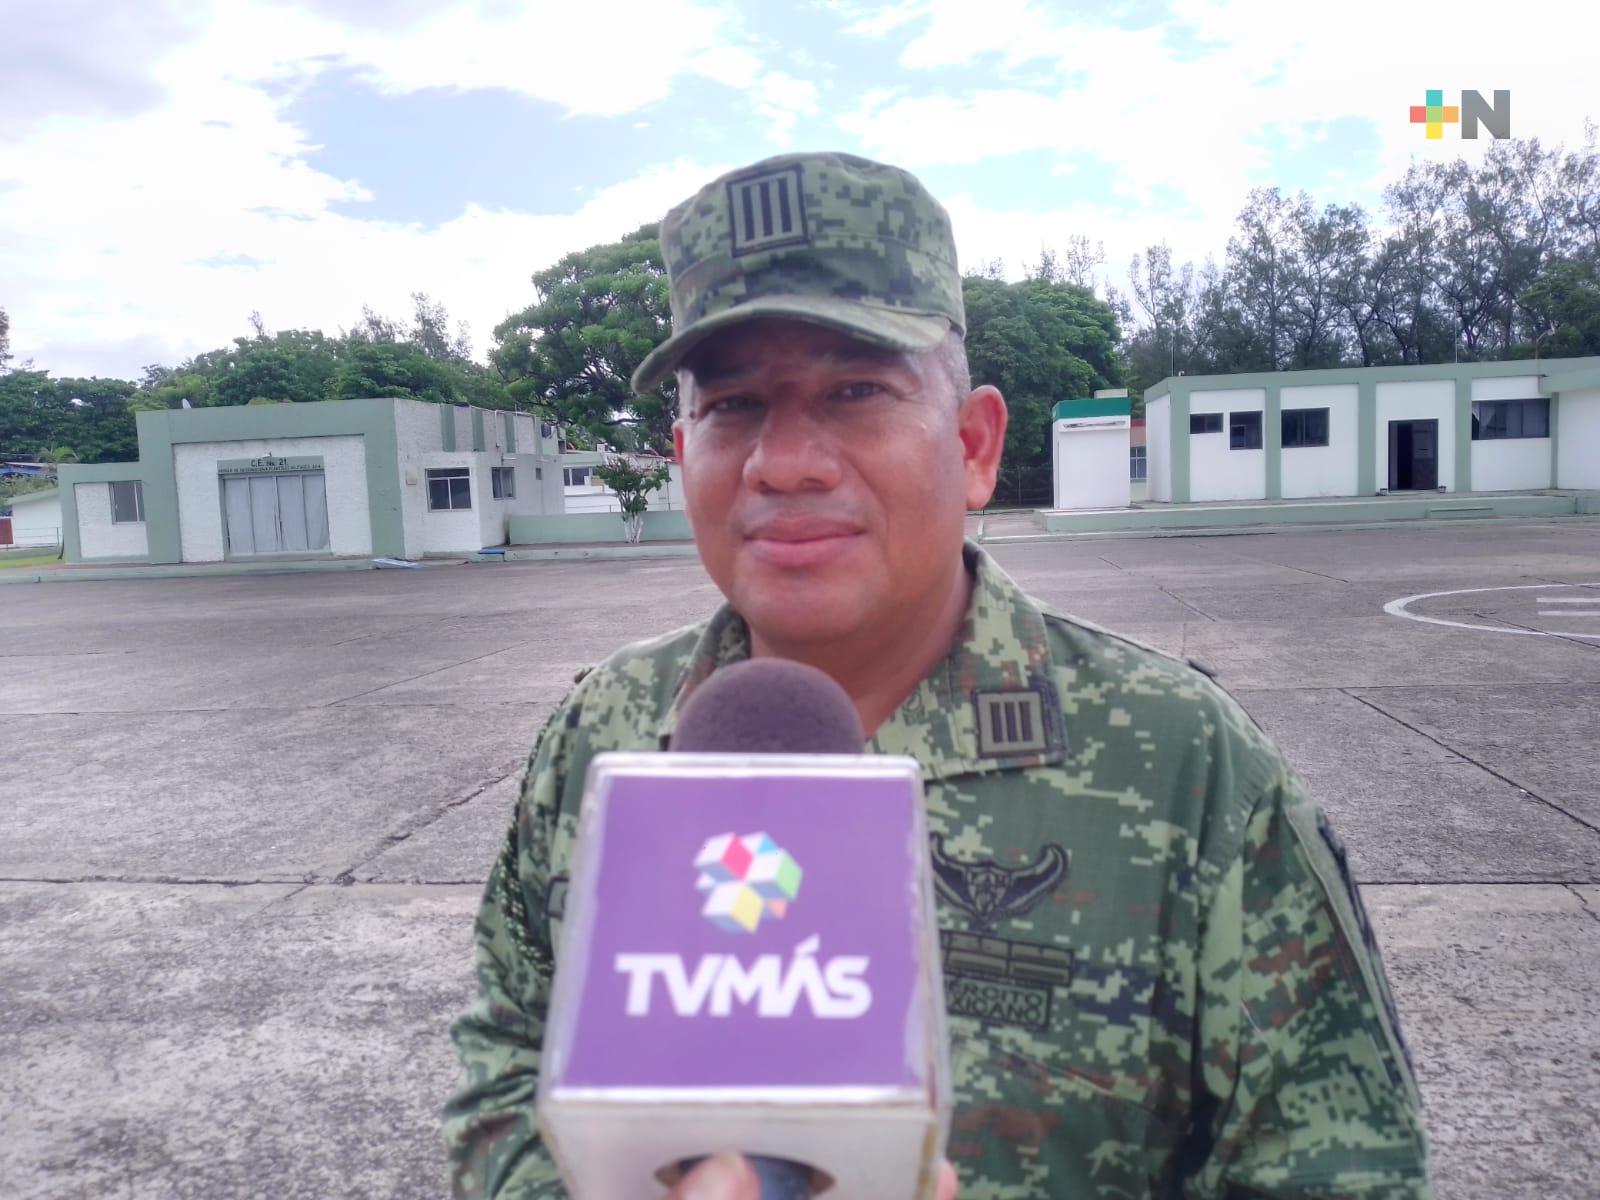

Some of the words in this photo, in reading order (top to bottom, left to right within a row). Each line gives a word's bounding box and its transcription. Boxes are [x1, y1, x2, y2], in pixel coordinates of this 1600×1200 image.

[251, 459, 264, 467] C.E.
[614, 934, 872, 1018] TVMÁS
[948, 994, 1041, 1021] XICANO
